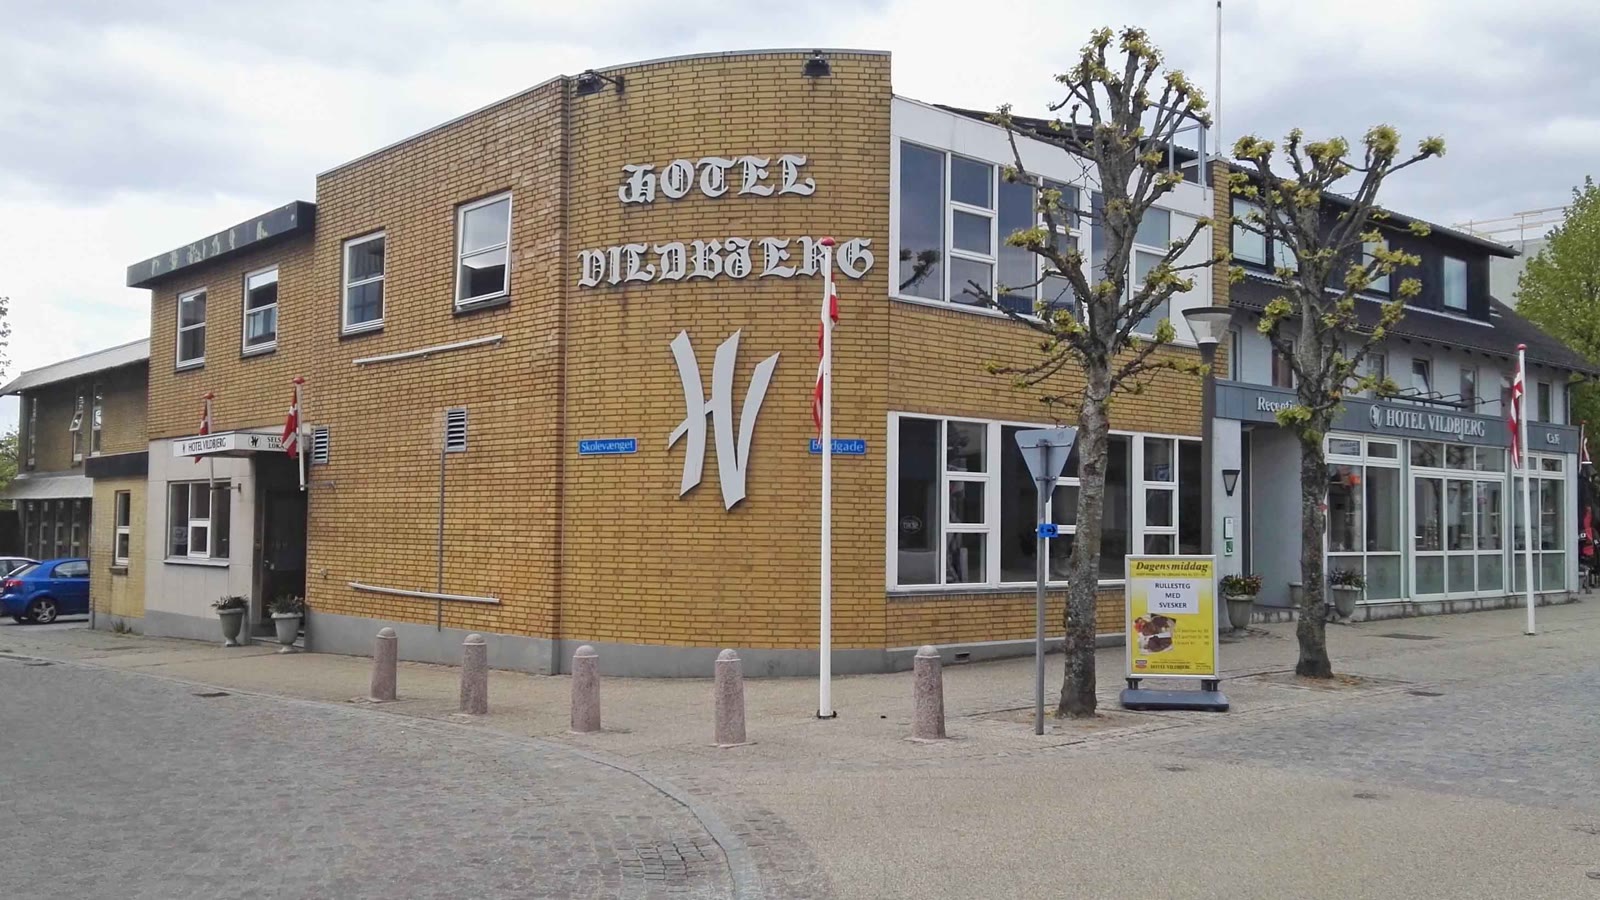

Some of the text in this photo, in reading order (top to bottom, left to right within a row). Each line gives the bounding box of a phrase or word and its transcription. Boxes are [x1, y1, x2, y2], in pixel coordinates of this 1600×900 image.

[618, 154, 816, 203] HOTEL
[577, 236, 875, 288] VILDBJERG
[1386, 409, 1486, 440] HOTEL VILDBJERG
[188, 437, 227, 452] HOTEL VILDBJERG
[581, 440, 633, 452] Skolevænget
[812, 440, 864, 453] Brdgade
